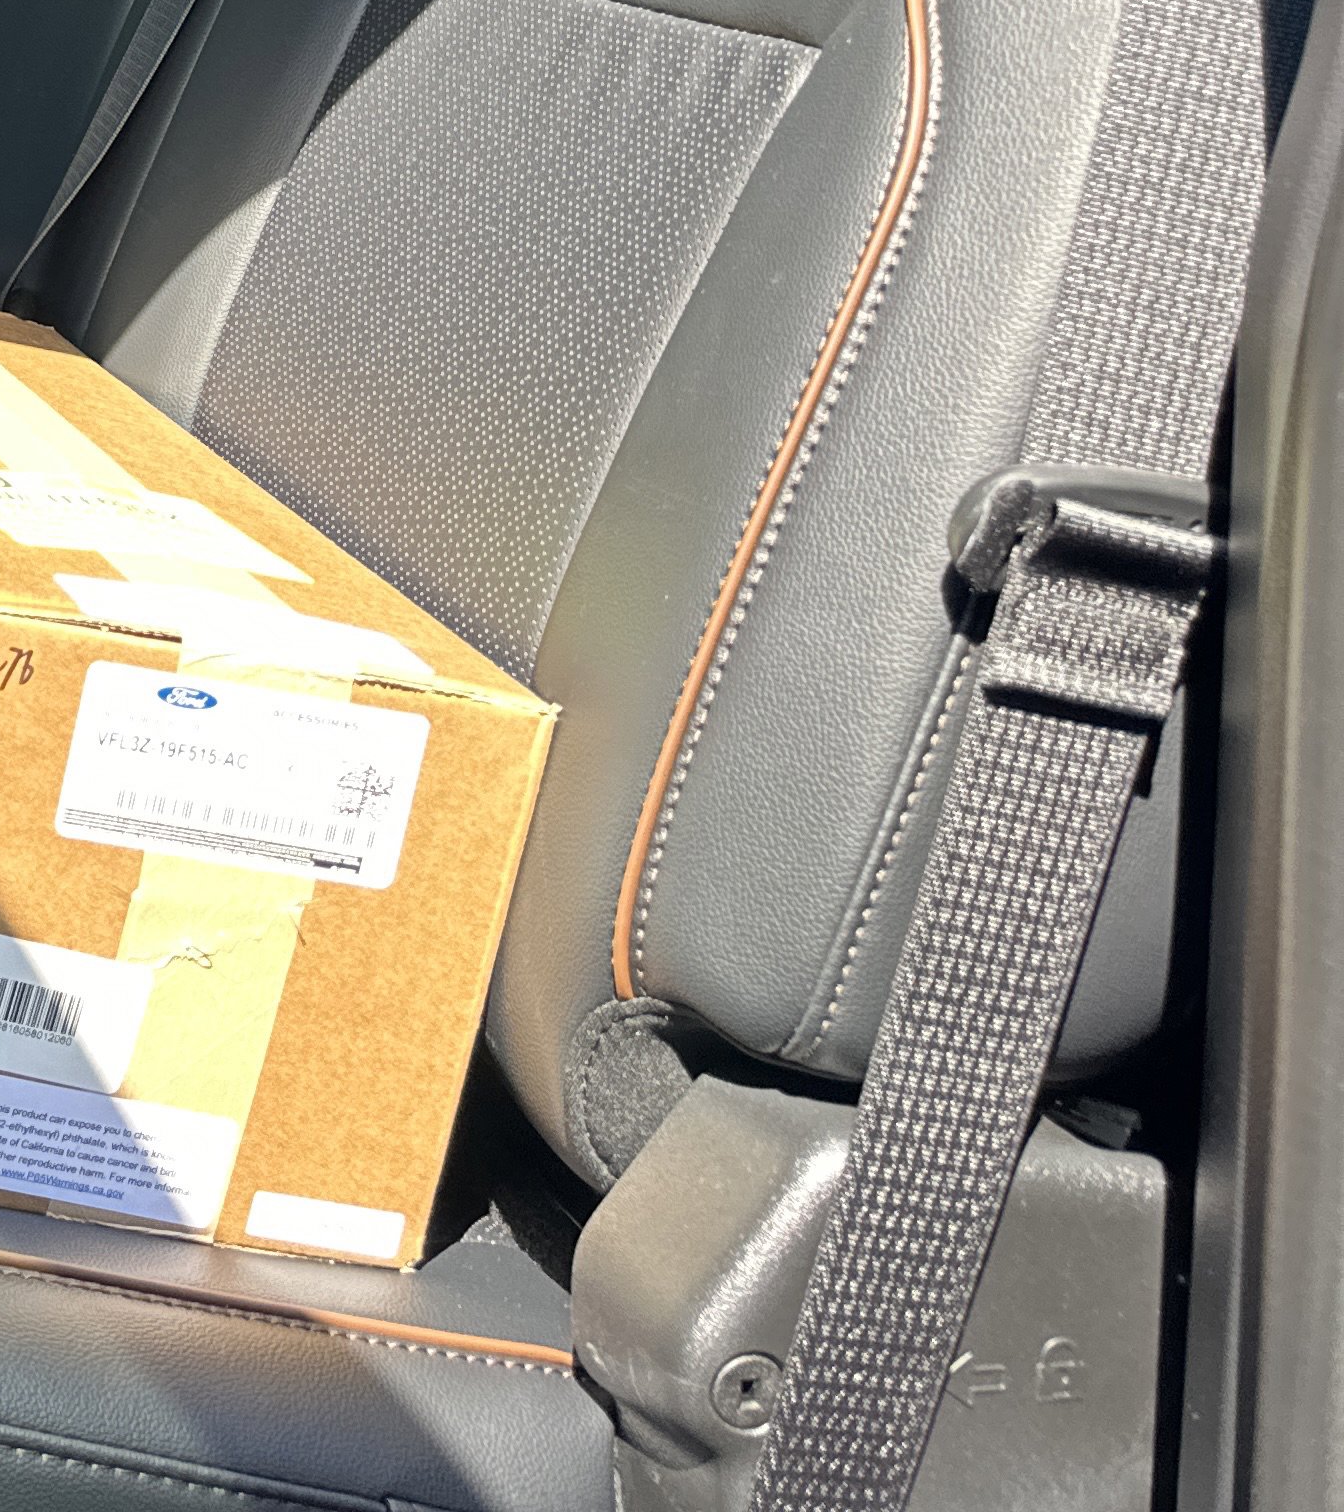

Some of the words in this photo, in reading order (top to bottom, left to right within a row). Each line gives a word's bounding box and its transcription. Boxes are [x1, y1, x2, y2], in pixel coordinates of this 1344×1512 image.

[162, 686, 213, 710] Ford
[12, 1107, 48, 1123] product
[49, 1115, 66, 1126] can
[68, 1119, 102, 1133] expose
[103, 1126, 121, 1137] you
[122, 1128, 132, 1138] to
[9, 1137, 20, 1148] of
[21, 1139, 64, 1157] California
[66, 1148, 76, 1158] to
[77, 1153, 105, 1164] cause
[107, 1158, 139, 1171] cancer
[140, 1164, 158, 1176] and
[111, 1142, 139, 1155] which
[141, 1148, 150, 1158] is
[18, 1156, 78, 1175] reproductive
[79, 1167, 106, 1180] harm.
[109, 1172, 126, 1184] For
[127, 1178, 152, 1189] more
